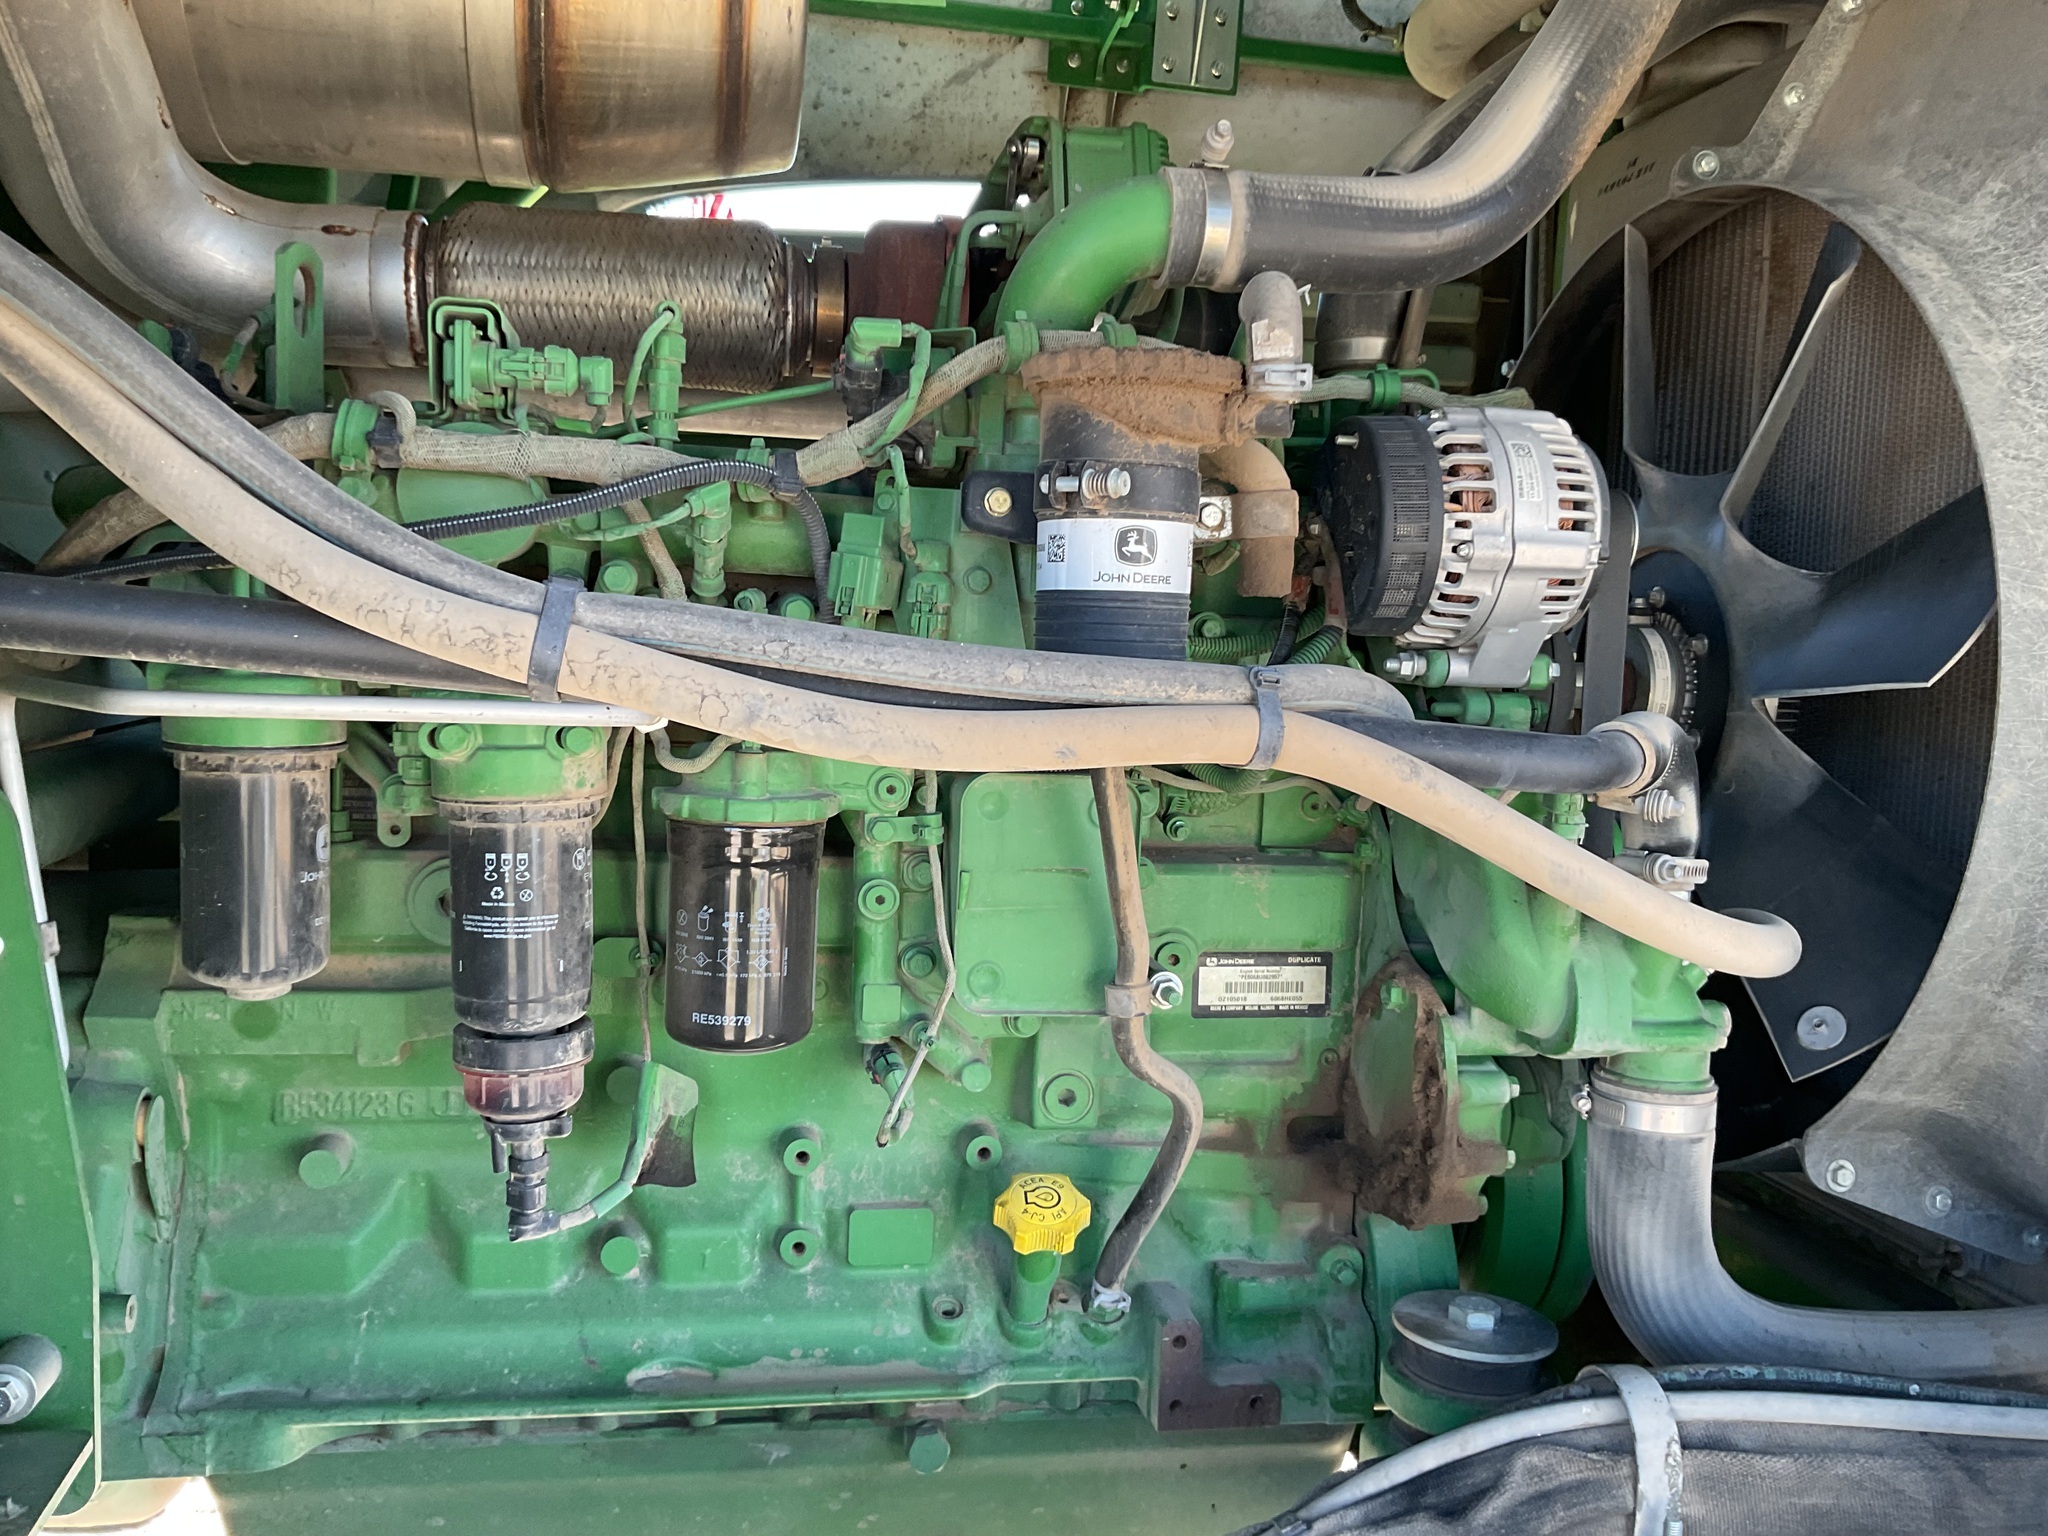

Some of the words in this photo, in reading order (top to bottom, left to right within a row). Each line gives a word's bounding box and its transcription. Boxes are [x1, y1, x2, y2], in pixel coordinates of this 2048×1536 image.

[1093, 570, 1130, 583] JOHN
[1133, 572, 1172, 585] DEERE
[1218, 957, 1235, 965] JOHN
[1235, 957, 1255, 965] DEERE
[1287, 956, 1322, 964] DUPLICATE
[692, 1012, 752, 1027] RE539279
[1018, 1177, 1045, 1190] ACEA
[1050, 1180, 1065, 1189] E9
[1021, 1207, 1046, 1222] CJ-4
[1052, 1207, 1068, 1221] API
